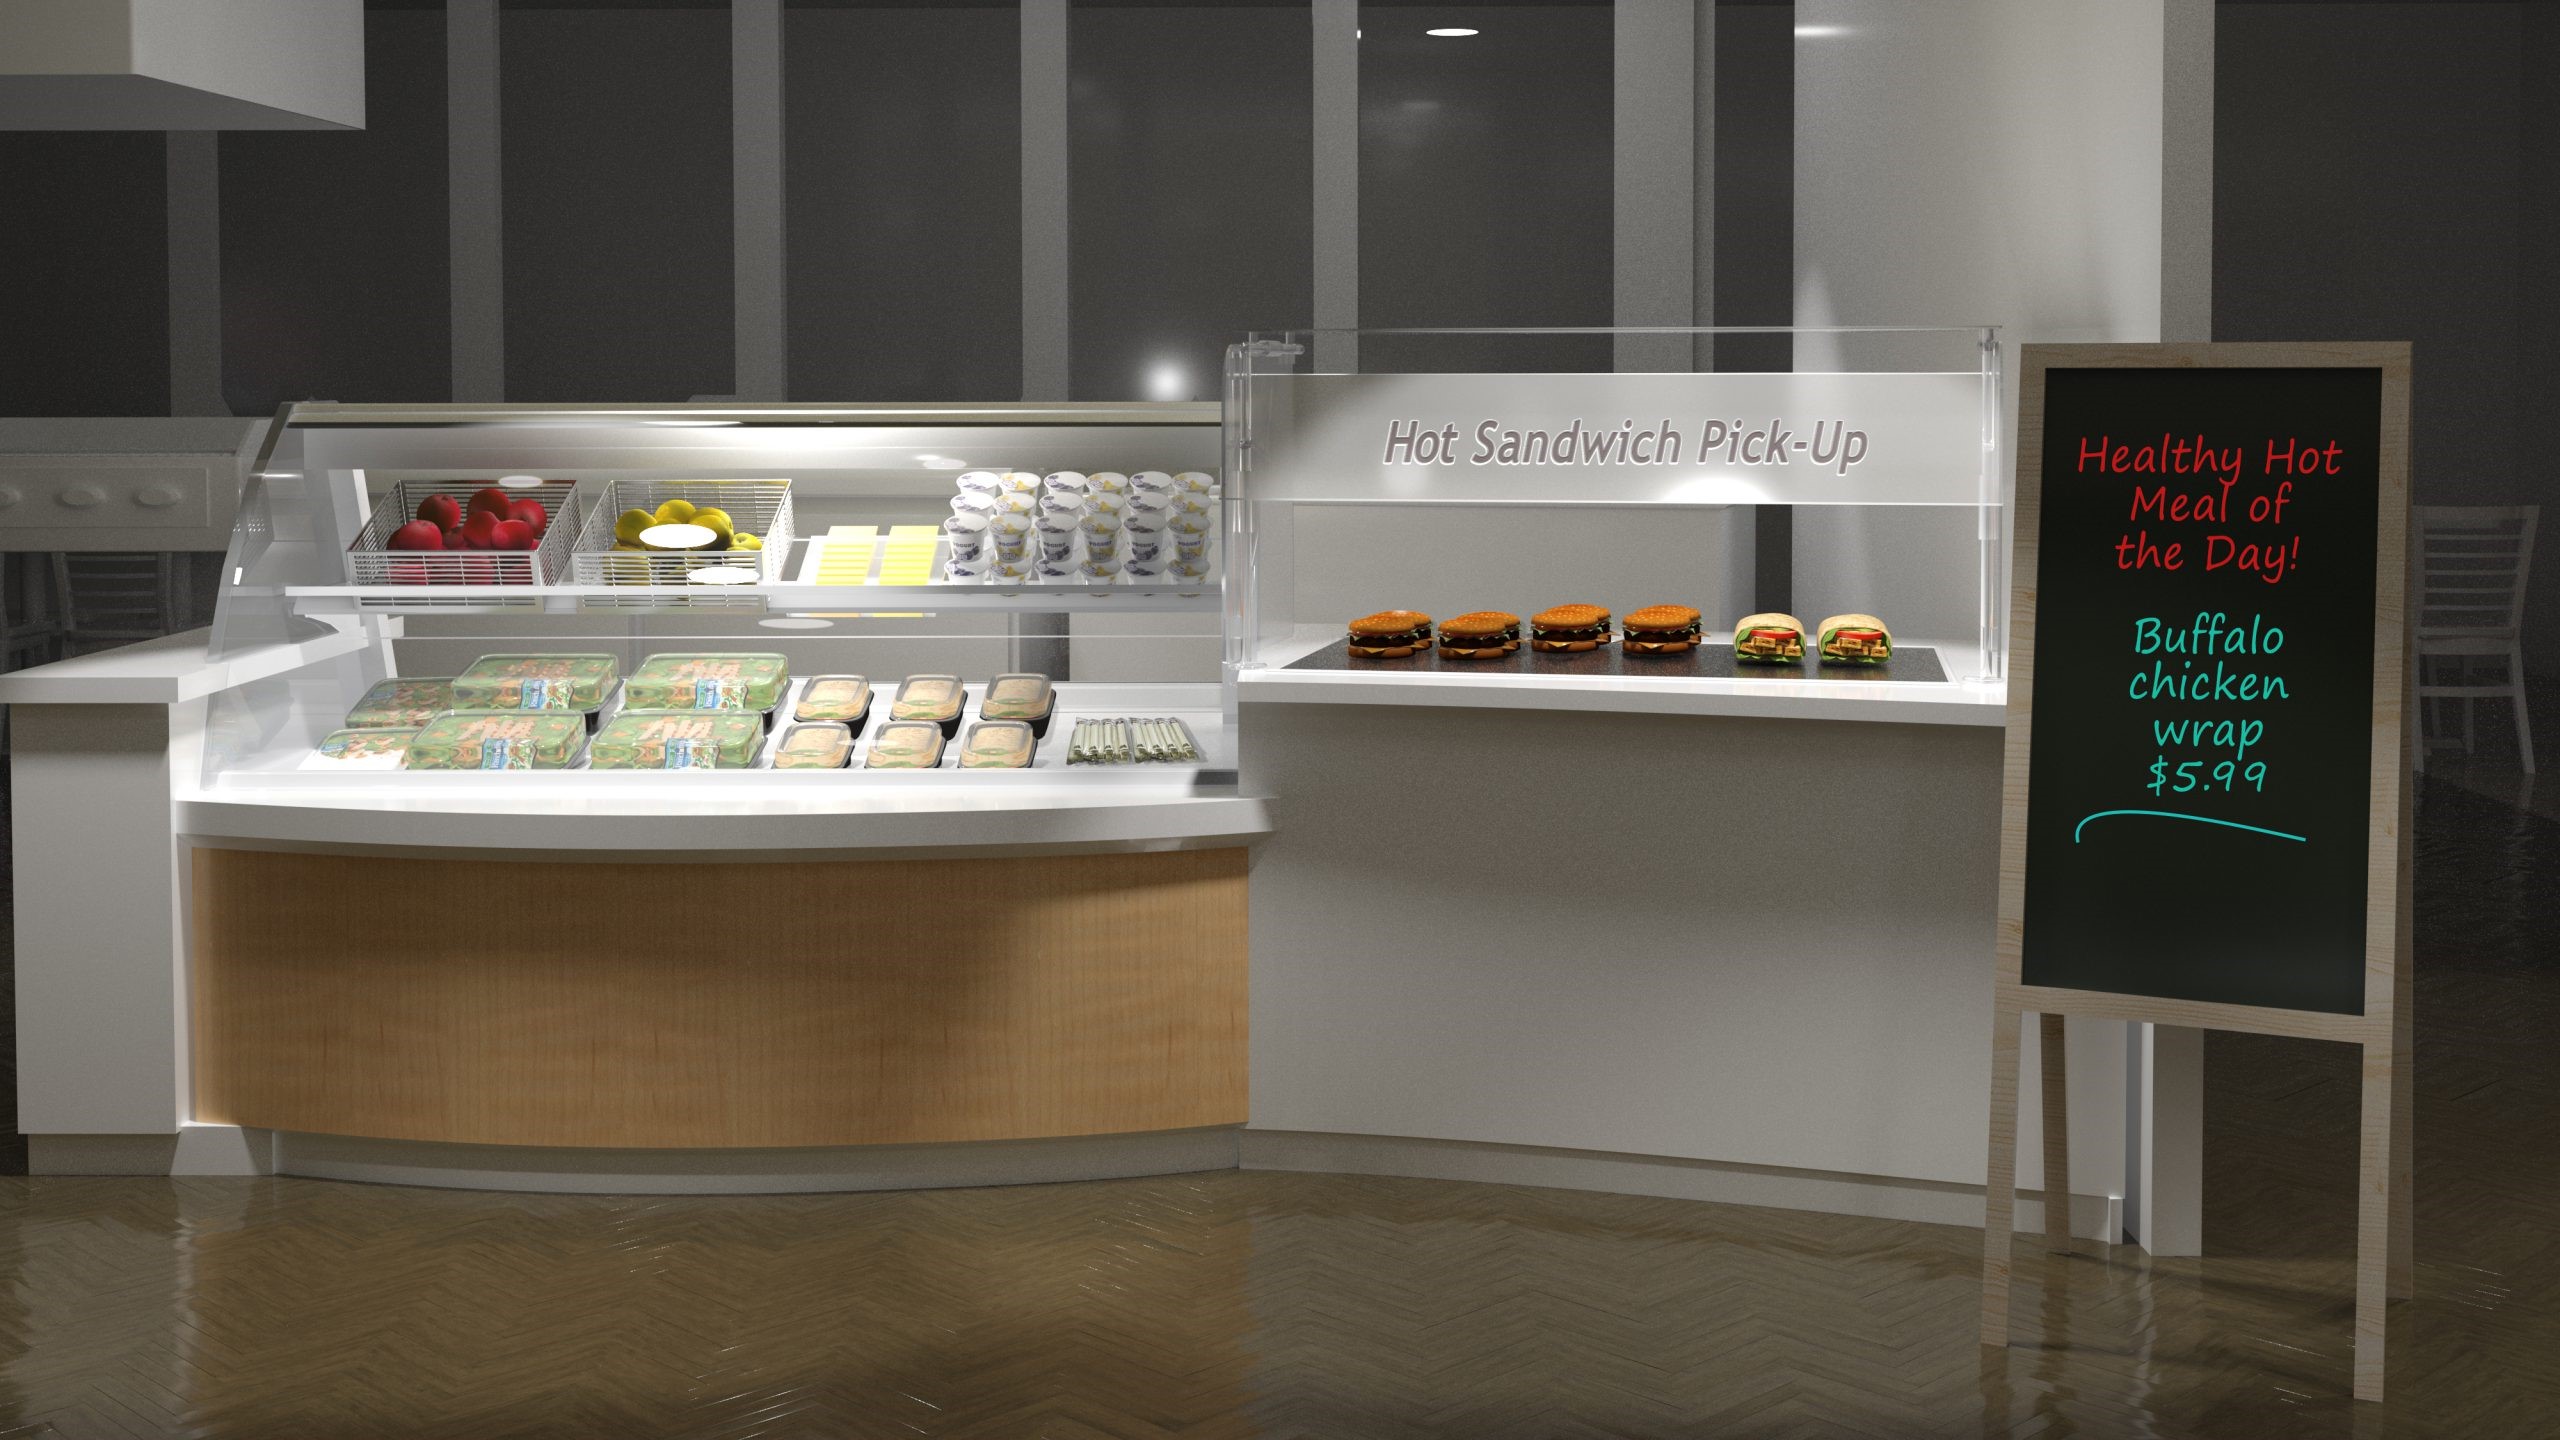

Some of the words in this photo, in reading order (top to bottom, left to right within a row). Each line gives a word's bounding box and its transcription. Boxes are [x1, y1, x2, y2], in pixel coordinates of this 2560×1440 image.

[1383, 420, 1459, 465] Hot
[1470, 418, 1682, 465] Sandwich
[1696, 418, 1868, 476] Pick-Up
[2078, 433, 2242, 486] Healthy
[2265, 438, 2342, 475] Hot
[2131, 479, 2229, 522] Meal
[2250, 481, 2292, 523] of
[2115, 531, 2183, 571] the
[2206, 535, 2299, 583] Day!
[2135, 611, 2284, 656] Buffalo
[2129, 660, 2288, 701] chicken
[2153, 720, 2264, 762] wrap
[2147, 755, 2267, 796] $5.99
